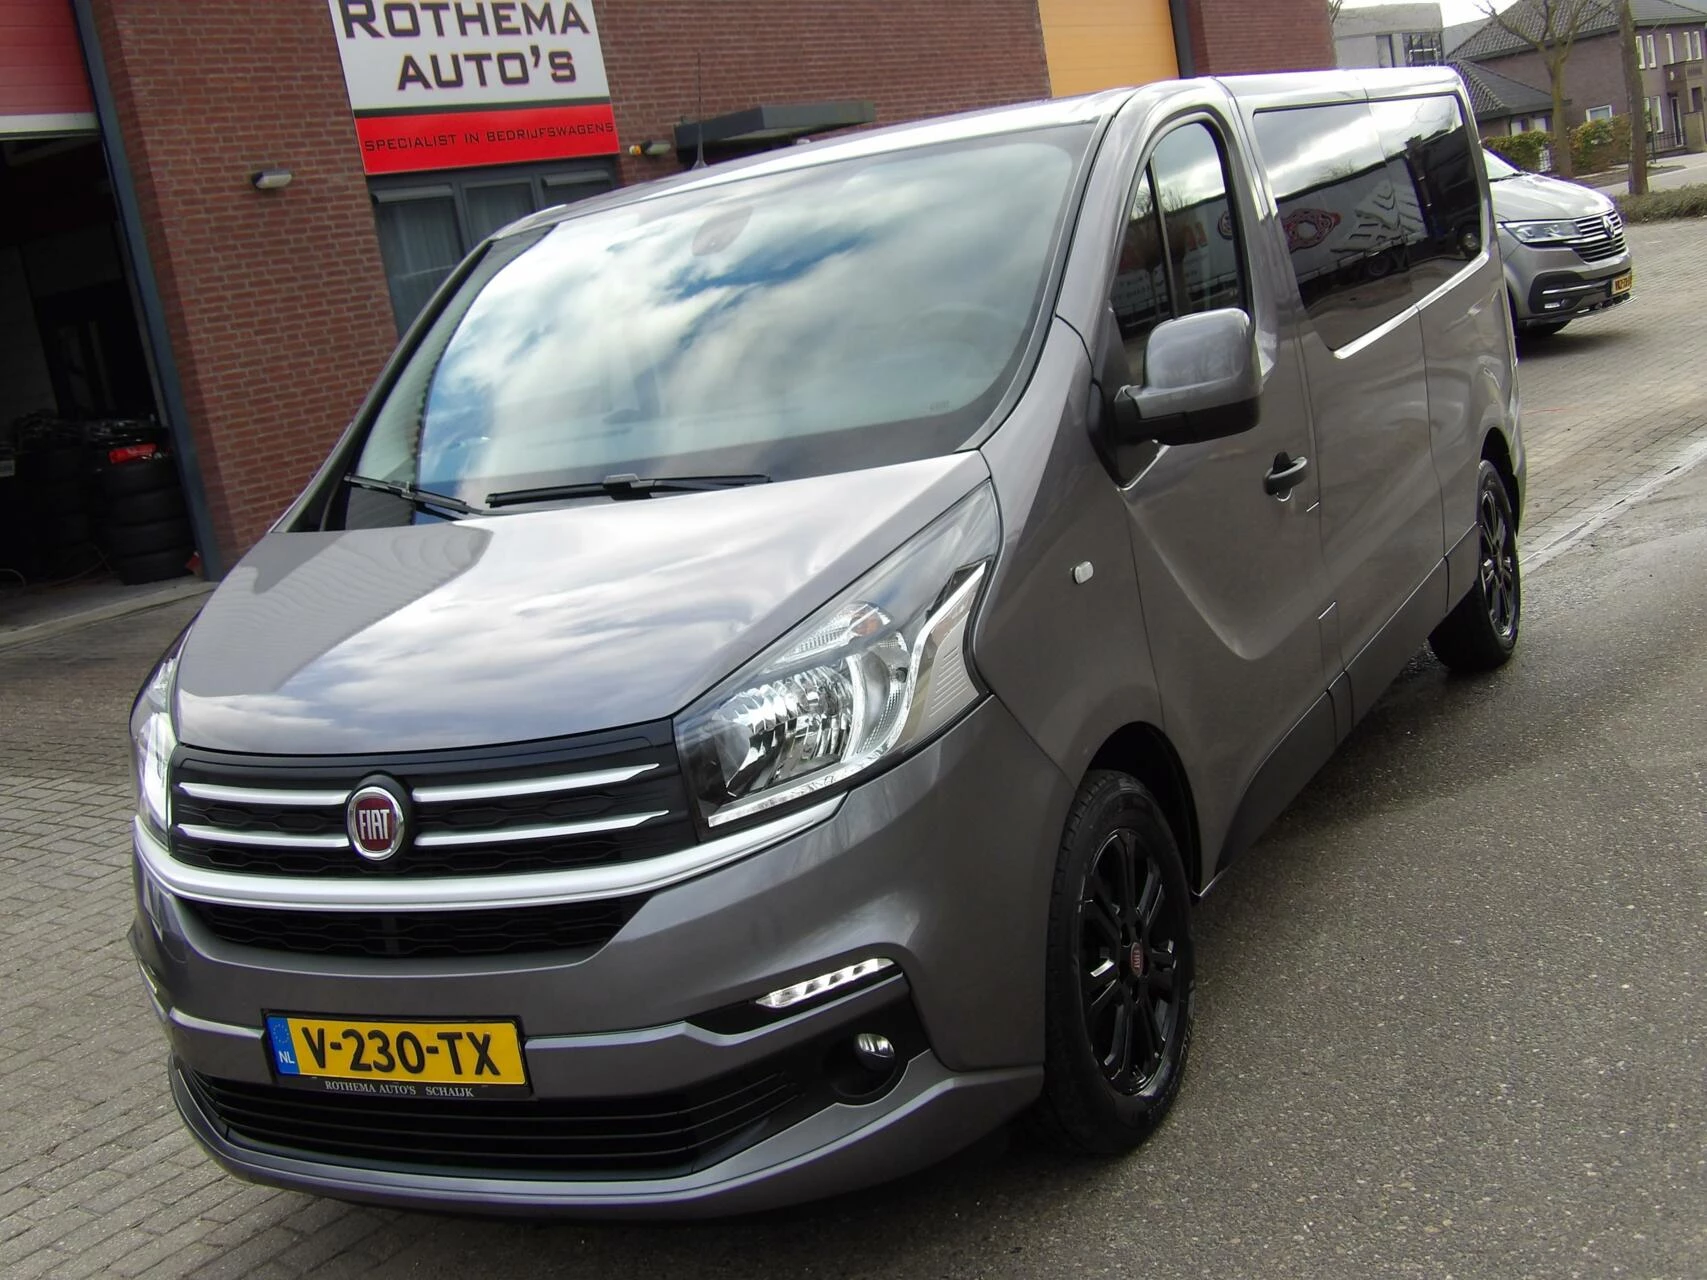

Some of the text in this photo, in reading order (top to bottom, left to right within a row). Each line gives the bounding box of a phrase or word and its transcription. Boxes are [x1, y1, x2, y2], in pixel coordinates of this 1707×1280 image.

[340, 0, 590, 38] ROTHEMA
[397, 45, 577, 91] AUTO'S
[364, 122, 614, 152] SPECIALIST IN BEDRIJFSWAGENS
[358, 808, 390, 840] FIAT
[279, 1050, 295, 1064] NL
[301, 1026, 501, 1076] V-230-TX
[325, 1080, 376, 1093] ROTHEMA
[379, 1085, 416, 1095] AUTO'S
